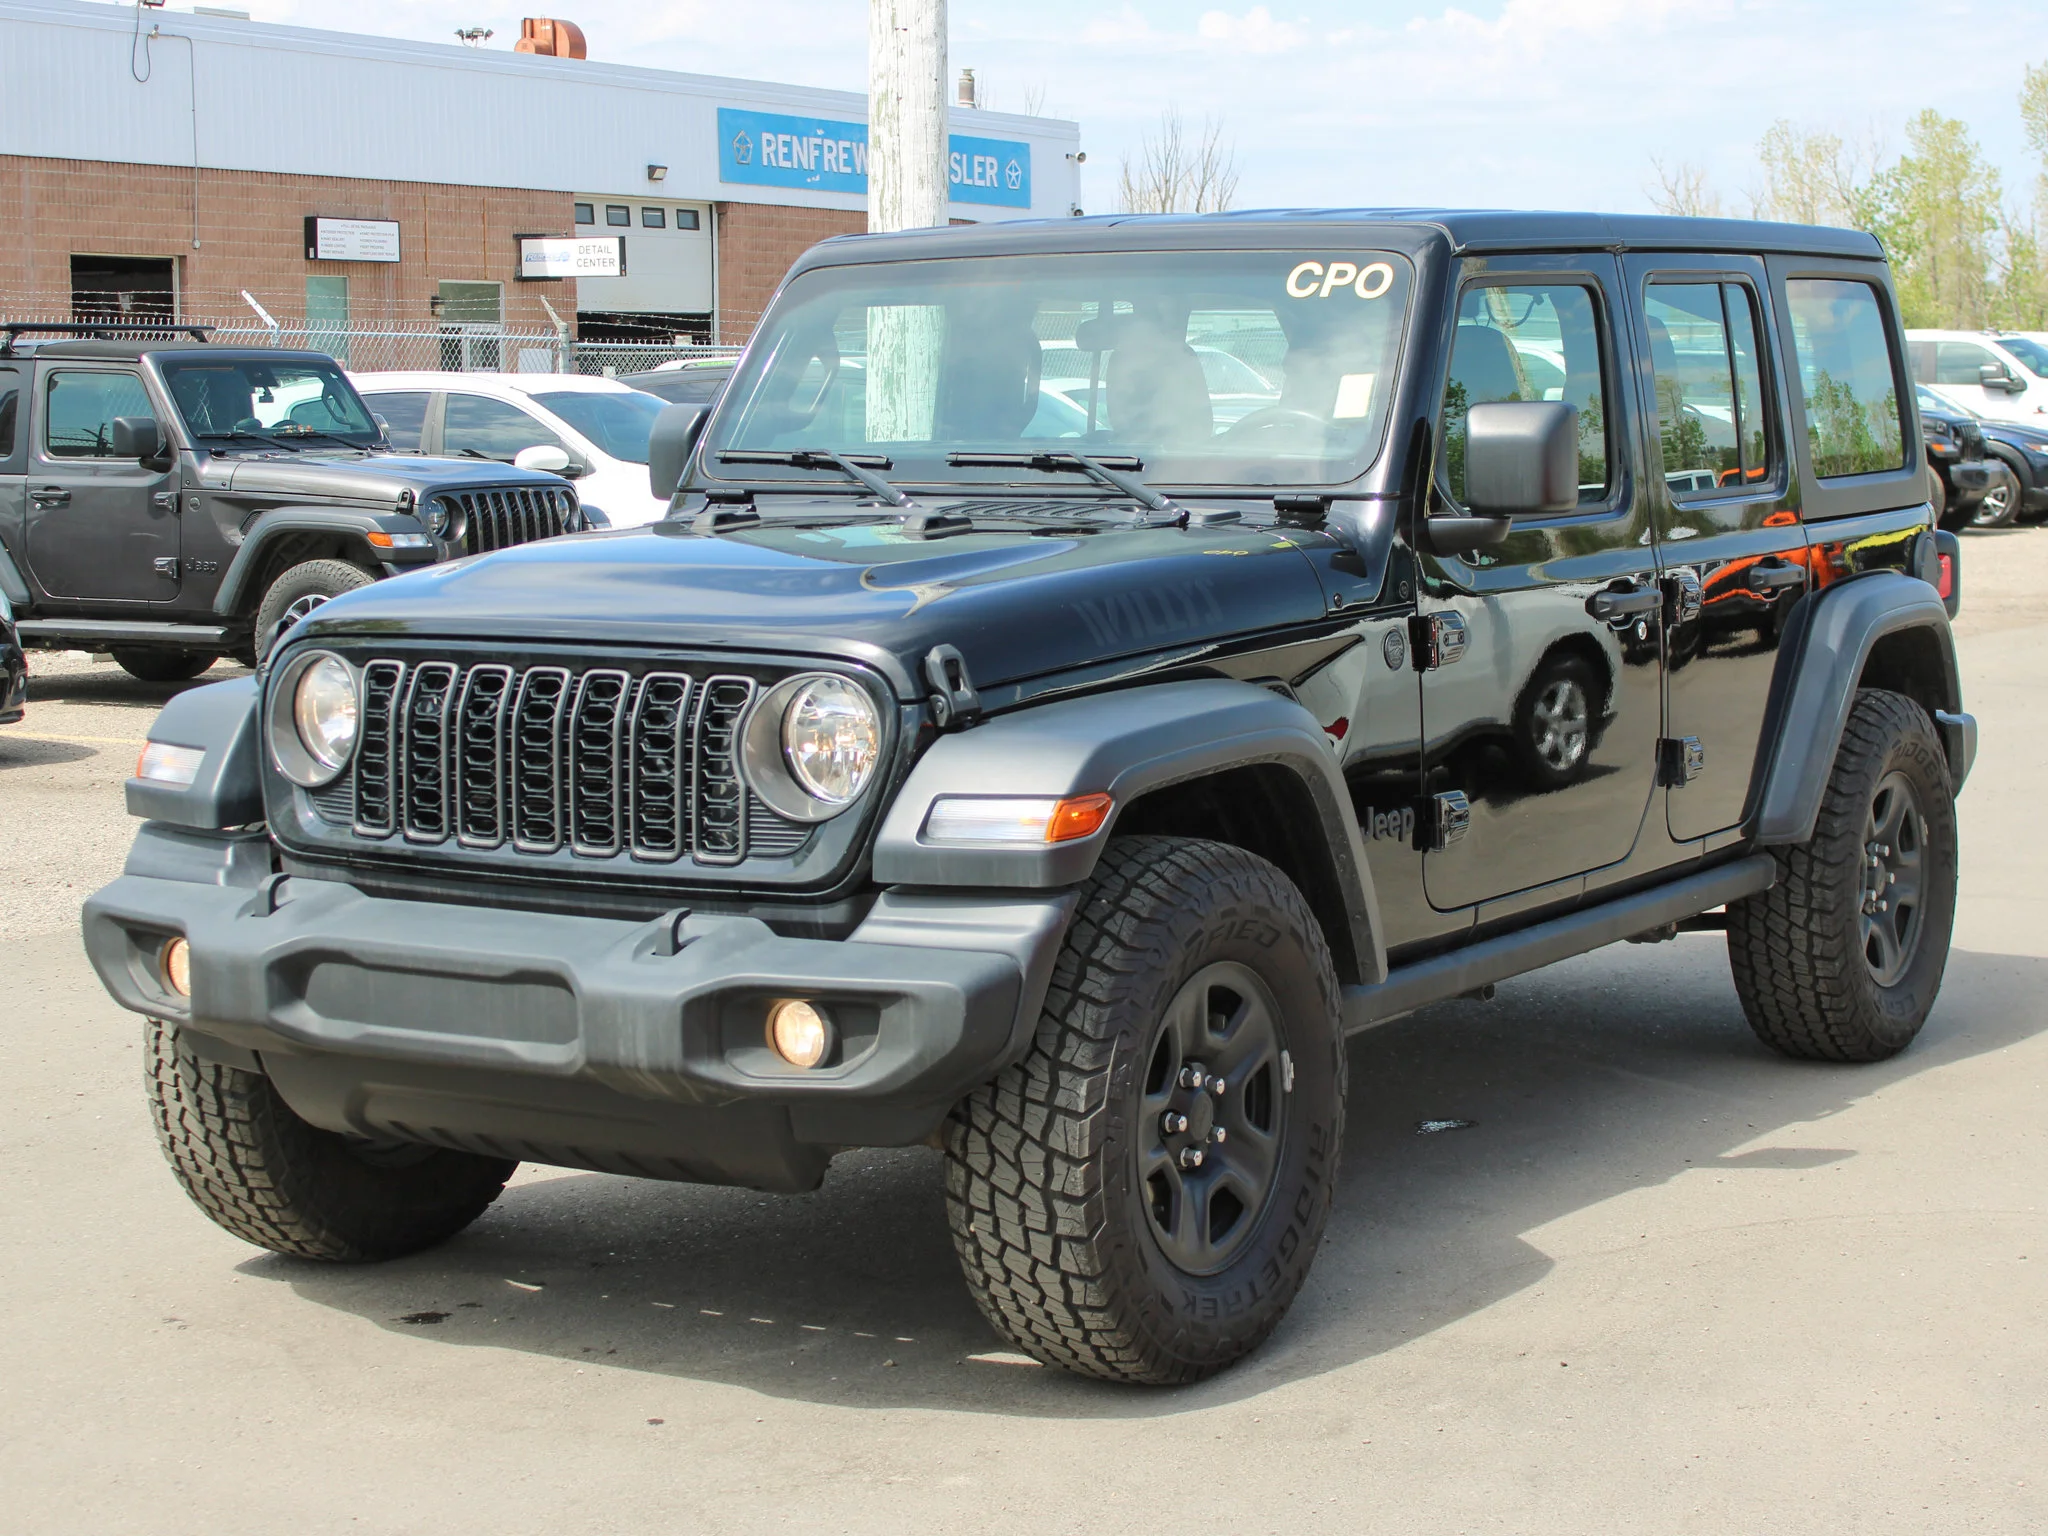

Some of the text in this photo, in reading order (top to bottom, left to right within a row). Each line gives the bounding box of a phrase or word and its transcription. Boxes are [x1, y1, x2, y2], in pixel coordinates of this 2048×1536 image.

[762, 132, 998, 187] RENFREW SLER
[577, 258, 616, 267] CENTER
[578, 245, 612, 254] DETAIL
[1286, 261, 1394, 299] CPO
[185, 557, 218, 574] Jeep
[1070, 577, 1223, 647] WILLYS
[1360, 806, 1415, 843] Jeep
[1181, 1122, 1328, 1320] RIDGETREK
